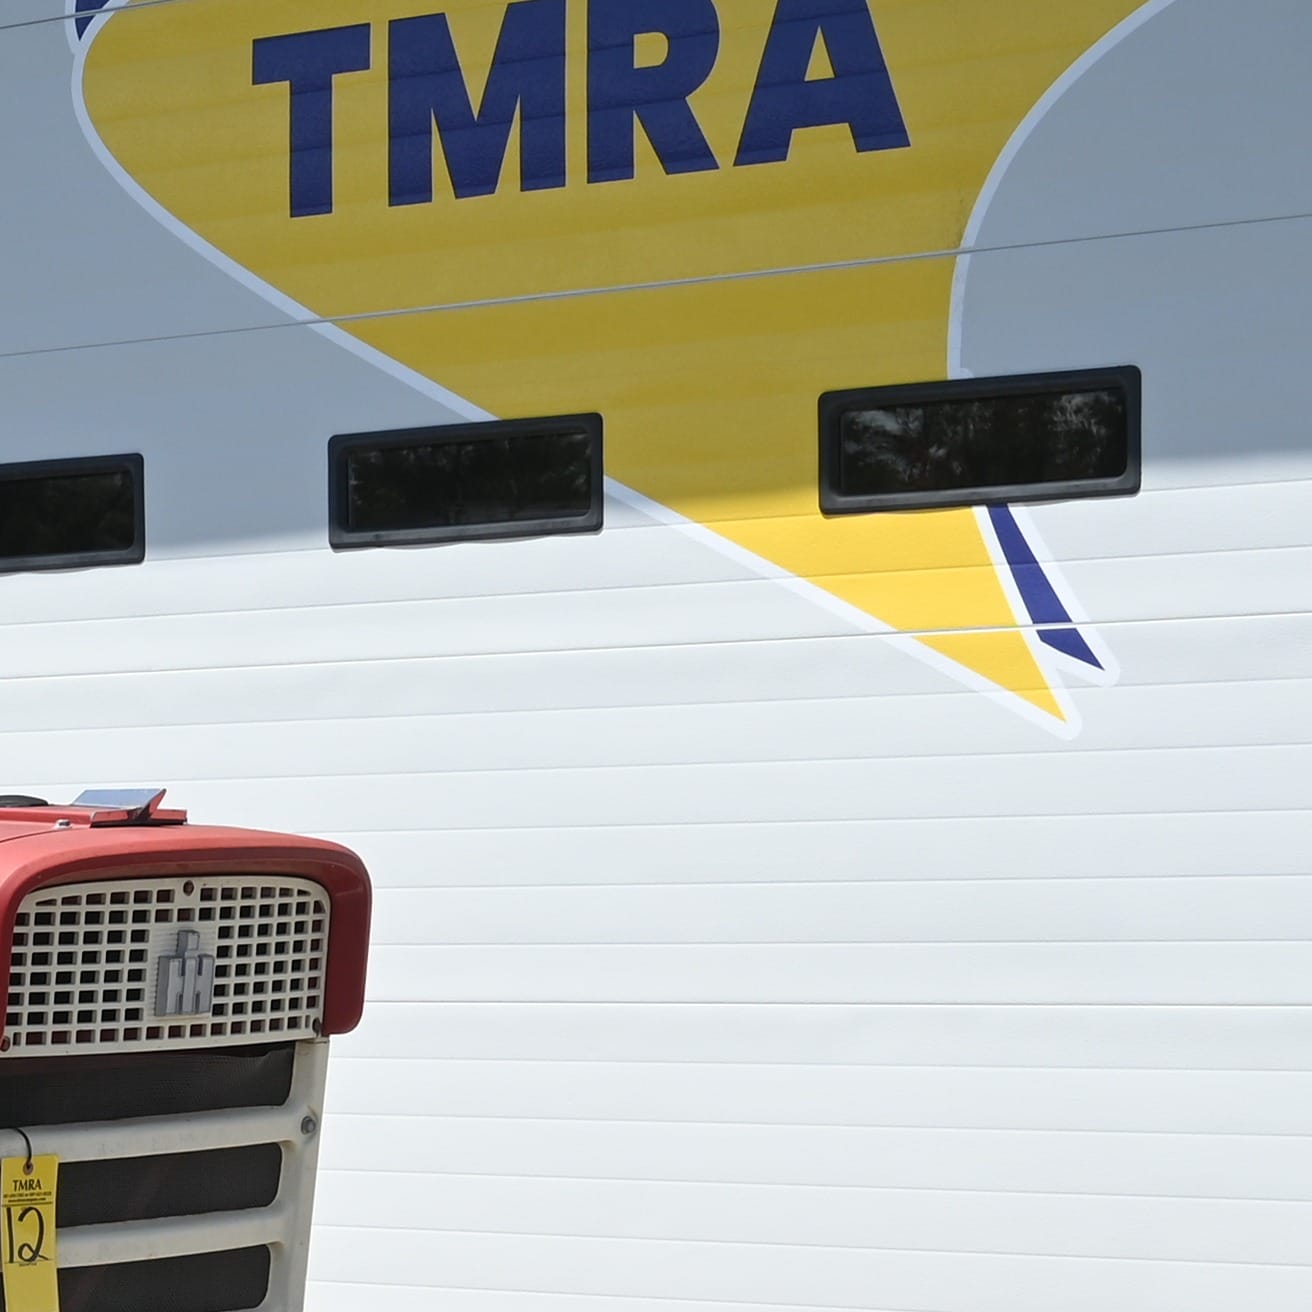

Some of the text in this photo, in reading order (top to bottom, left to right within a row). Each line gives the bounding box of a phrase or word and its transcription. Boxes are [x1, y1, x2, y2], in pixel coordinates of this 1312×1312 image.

[251, 0, 911, 218] TMRA
[12, 1178, 42, 1192] TMRA
[6, 1206, 50, 1264] 12
